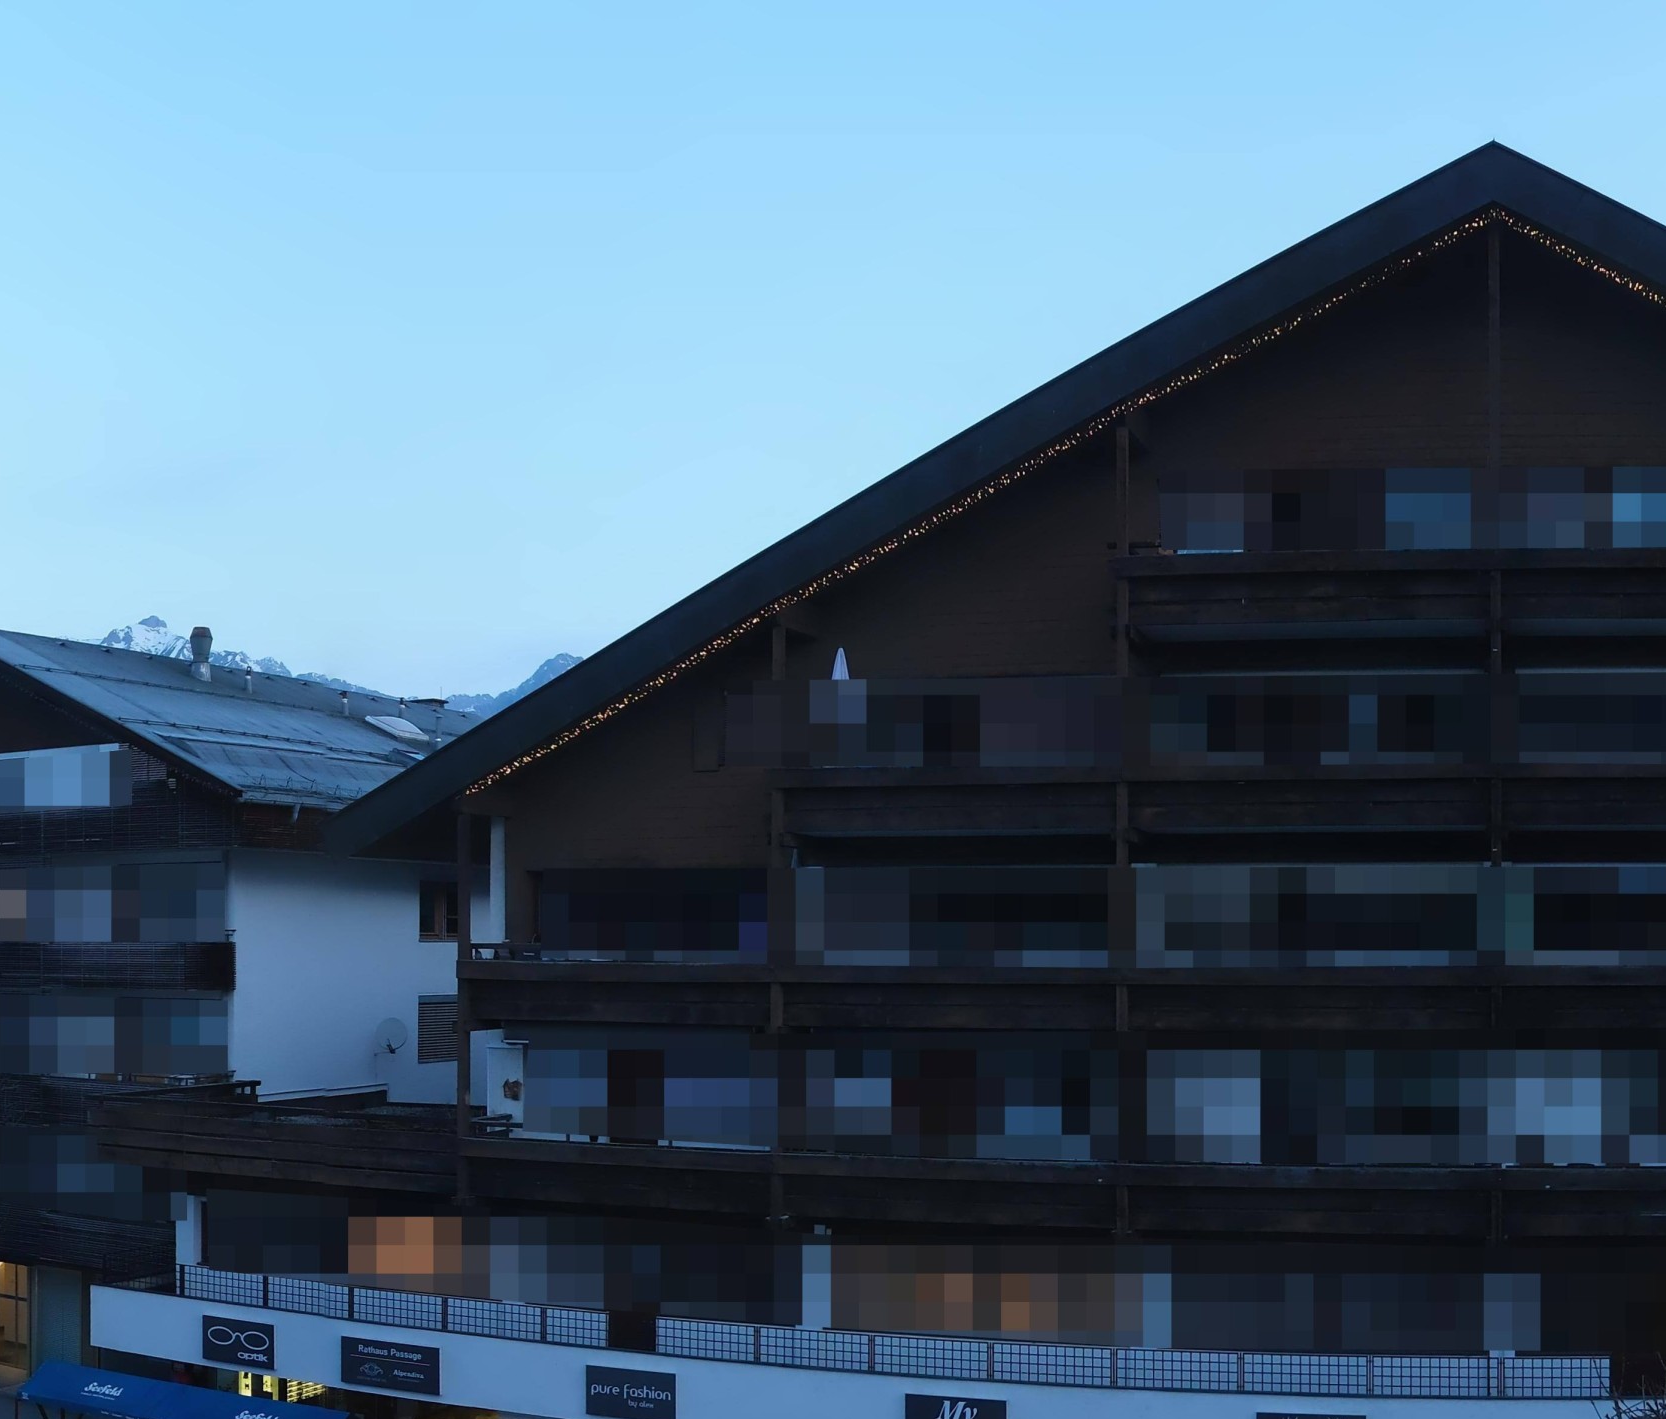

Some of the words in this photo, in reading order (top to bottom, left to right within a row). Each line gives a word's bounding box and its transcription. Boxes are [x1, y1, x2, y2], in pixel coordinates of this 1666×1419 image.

[237, 1352, 268, 1362] optik
[358, 1344, 388, 1356] Rathaus
[390, 1348, 422, 1361] Passage
[84, 1382, 124, 1397] Seefeld
[591, 1383, 620, 1395] pure
[624, 1383, 671, 1401] fashion
[628, 1399, 637, 1408] by
